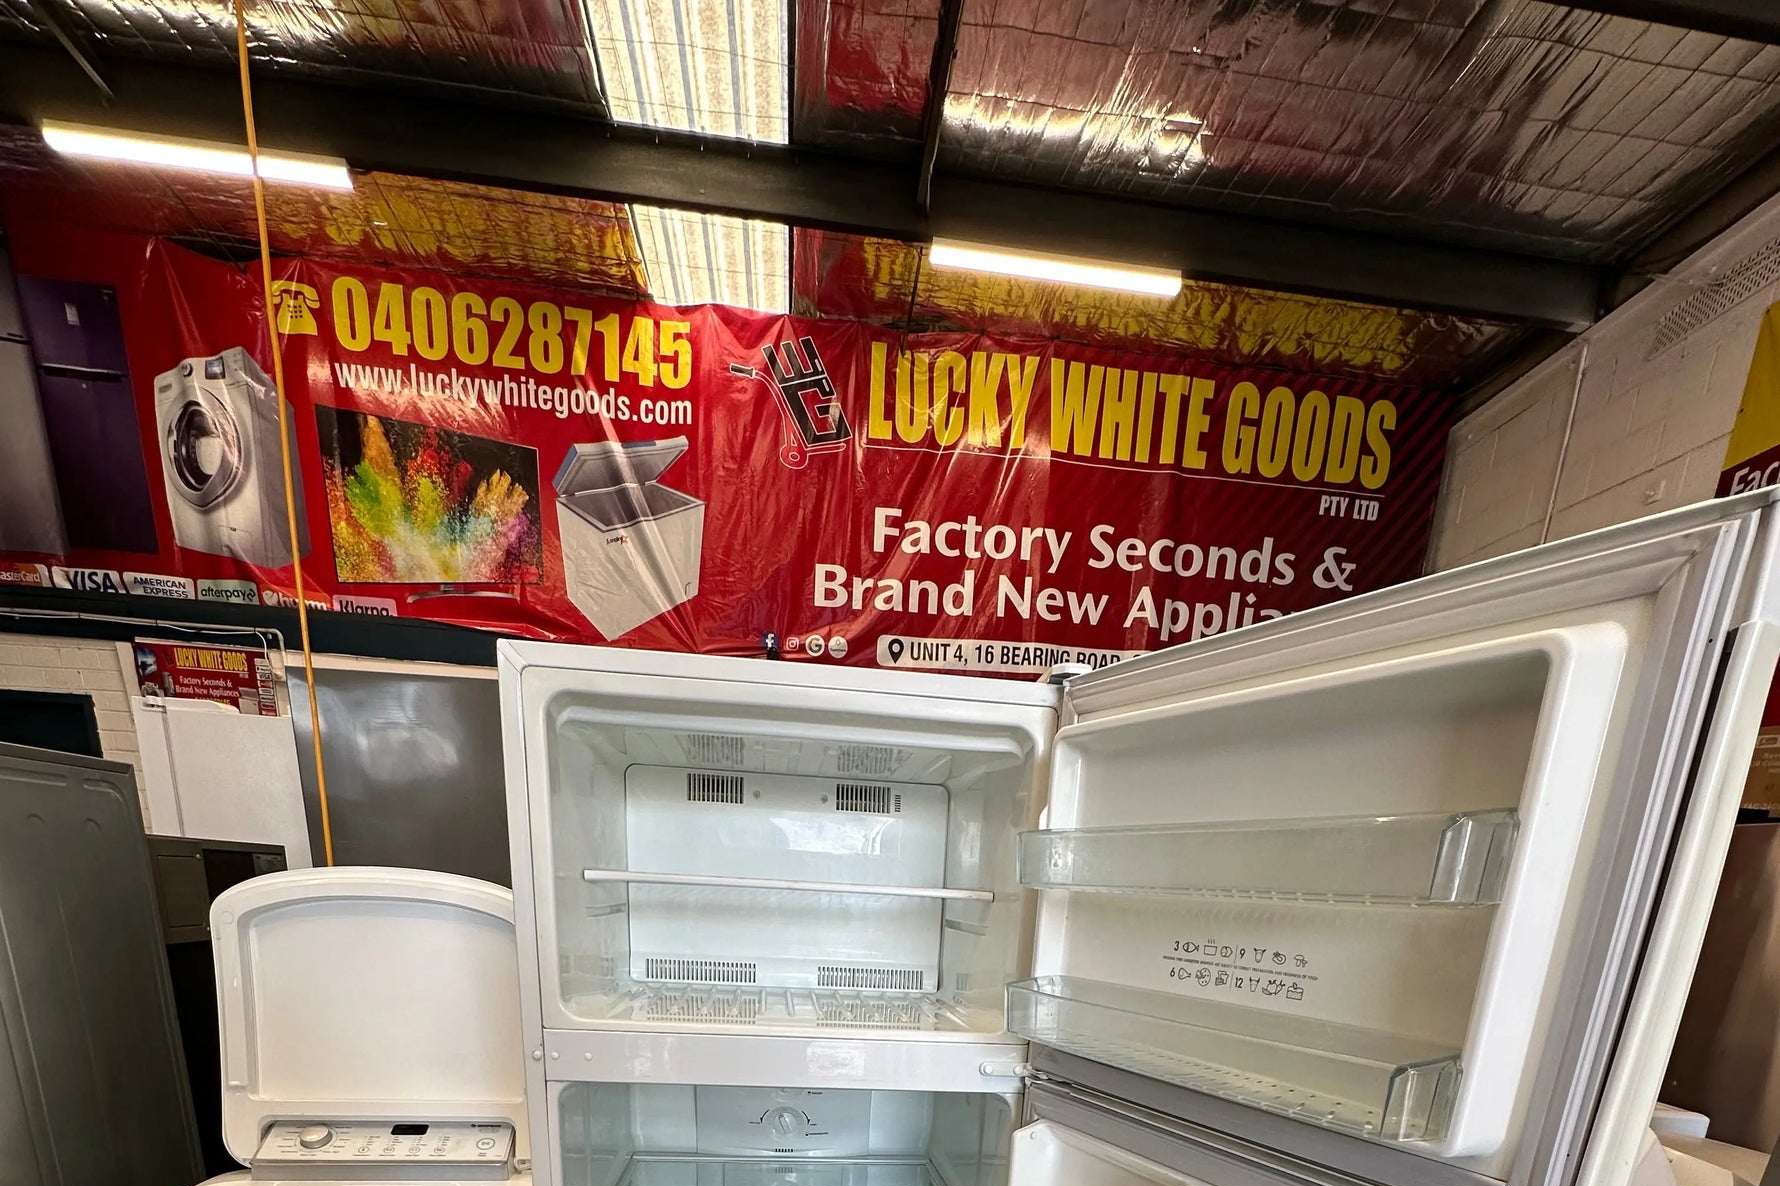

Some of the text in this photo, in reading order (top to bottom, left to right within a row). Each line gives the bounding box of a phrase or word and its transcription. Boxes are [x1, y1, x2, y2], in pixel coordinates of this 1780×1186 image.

[331, 276, 692, 390] 0406287145
[334, 362, 692, 425] www.luckywhitegoods.com
[868, 342, 1397, 489] LUCKY WHITE GOODS
[1730, 461, 1780, 496] Fac
[1319, 495, 1379, 521] PTY LTD
[872, 507, 1356, 591] Factory Seconds &
[0, 571, 40, 582] asterCard
[65, 570, 119, 593] VISA
[133, 577, 186, 590] AMERICAN
[143, 586, 188, 599] EXPRESS
[200, 586, 246, 601] afterpay
[814, 563, 1298, 641] Brand New Appli
[174, 648, 248, 672] LUCKY WHITE GOODS
[910, 641, 950, 662] UNIT
[953, 643, 968, 666] 4,
[975, 644, 994, 664] 16
[1000, 645, 1070, 668] BEARING
[175, 683, 239, 697] Brand New Appliances
[180, 676, 233, 688] Factory Seconds &
[1174, 941, 1246, 959] 3 9
[1170, 967, 1243, 989] 6 12
